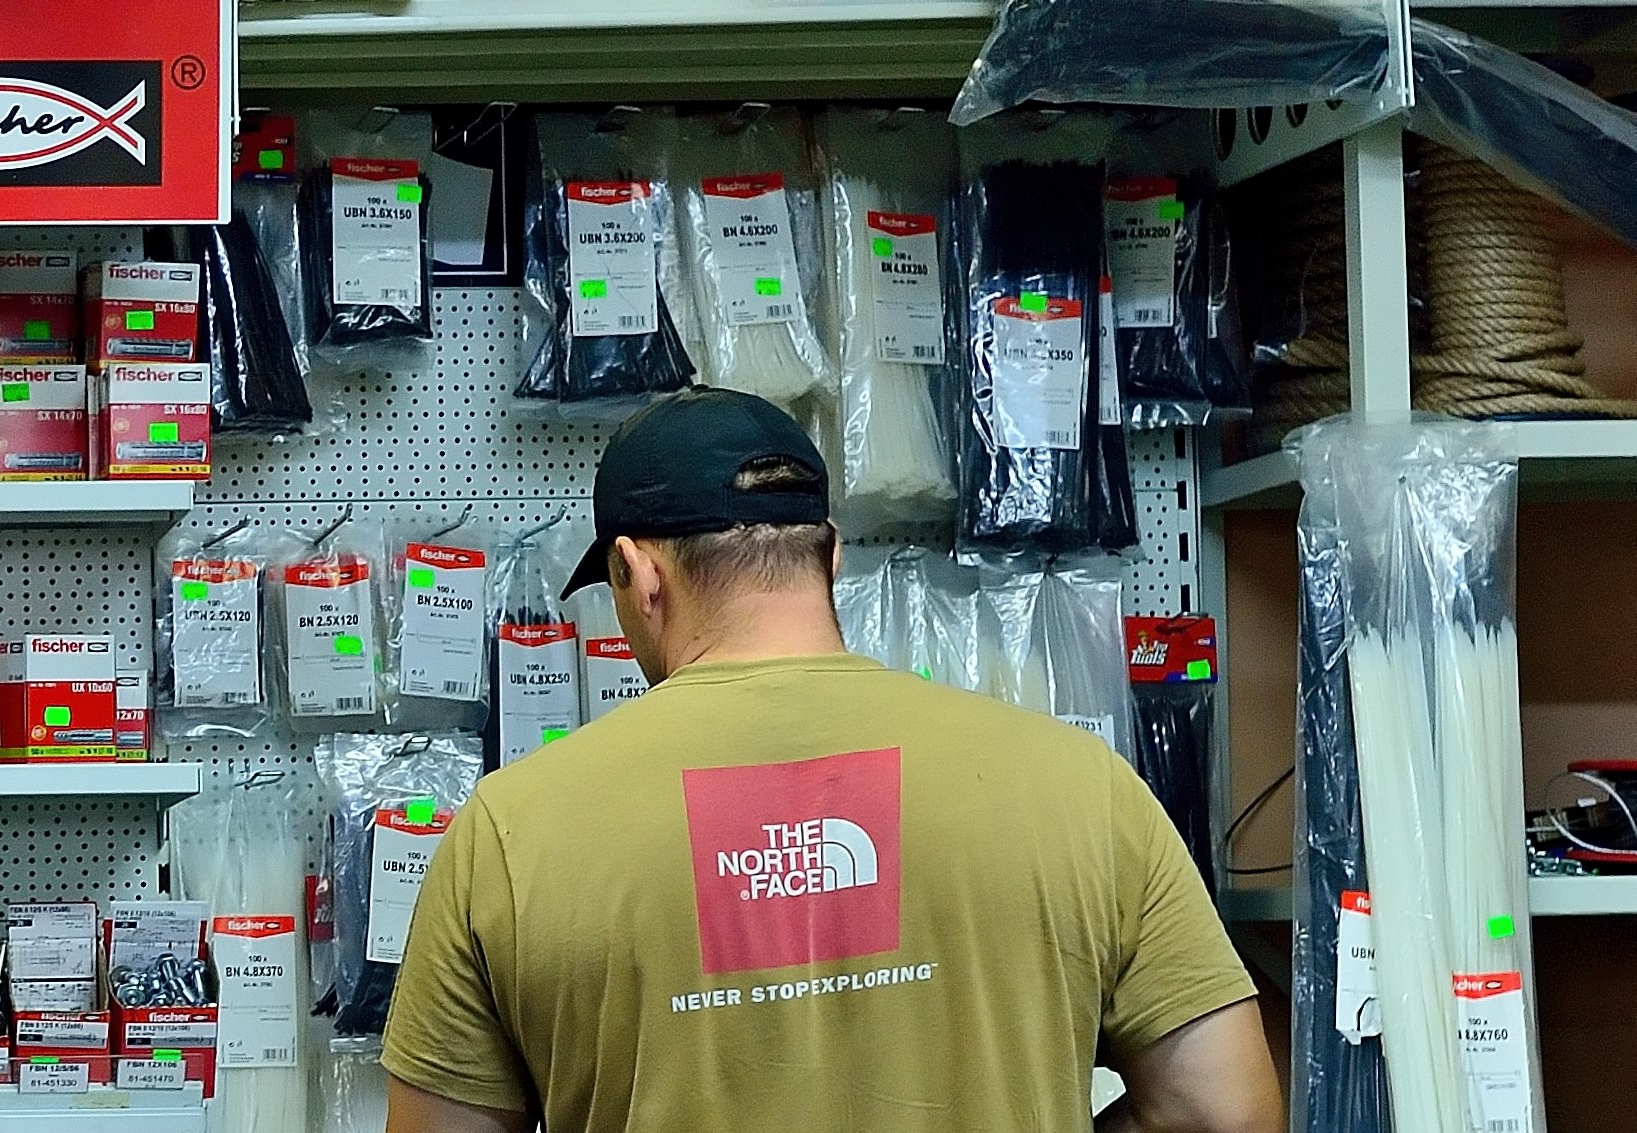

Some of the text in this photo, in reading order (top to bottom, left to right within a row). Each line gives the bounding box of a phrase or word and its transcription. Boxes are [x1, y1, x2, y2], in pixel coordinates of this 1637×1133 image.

[347, 162, 386, 174] fischer
[580, 186, 617, 199] fischer
[344, 208, 412, 222] UBN 3.6X150
[579, 232, 646, 246] UBN 3.6X200
[418, 595, 474, 611] BN 2.5X100
[299, 614, 358, 628] BN 2.5X120
[32, 638, 86, 653] fischer
[762, 818, 822, 849] THE
[717, 844, 824, 877] NORTH
[751, 868, 824, 900] FACE
[226, 966, 284, 978] BN 4.8X370
[671, 988, 742, 1014] NEVER
